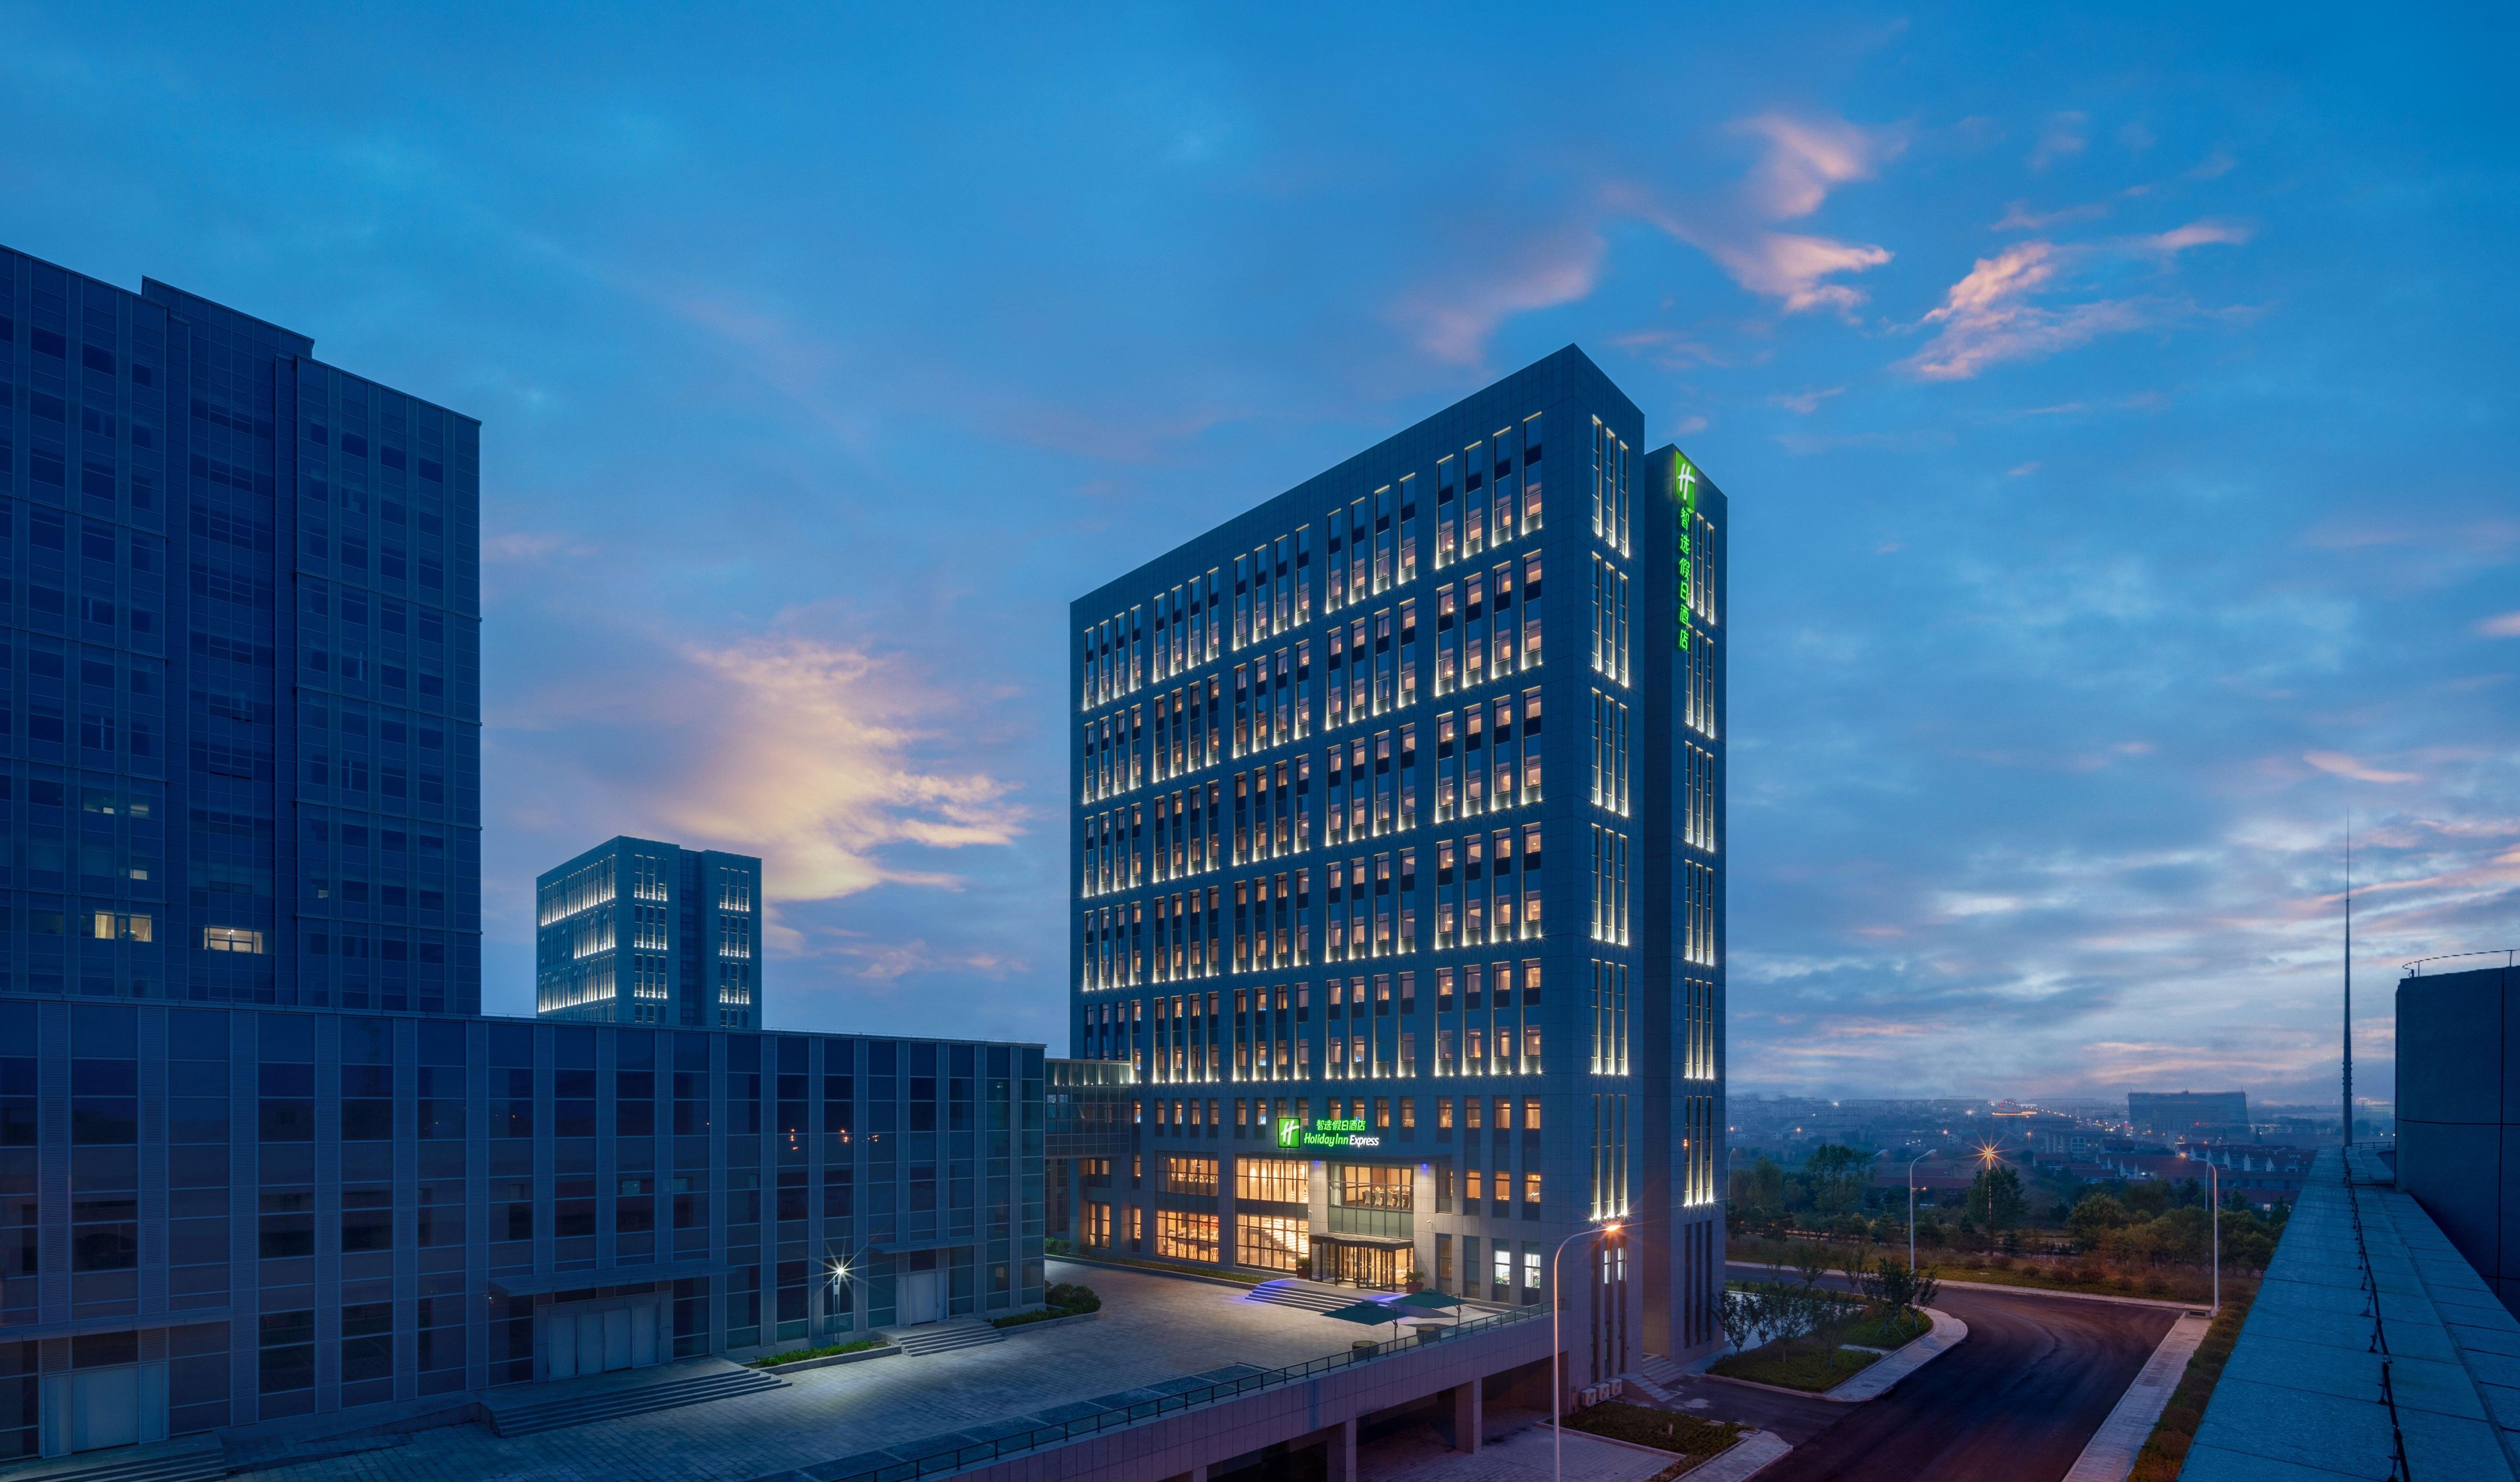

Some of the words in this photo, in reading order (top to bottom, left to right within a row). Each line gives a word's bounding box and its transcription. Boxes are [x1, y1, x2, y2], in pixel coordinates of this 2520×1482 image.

[1679, 507, 1690, 651] 智选假日酒店
[1316, 1119, 1366, 1131] 智选假日酒店
[1304, 1132, 1335, 1147] Holiday
[1335, 1134, 1349, 1145] Inn
[1349, 1135, 1379, 1147] Express
